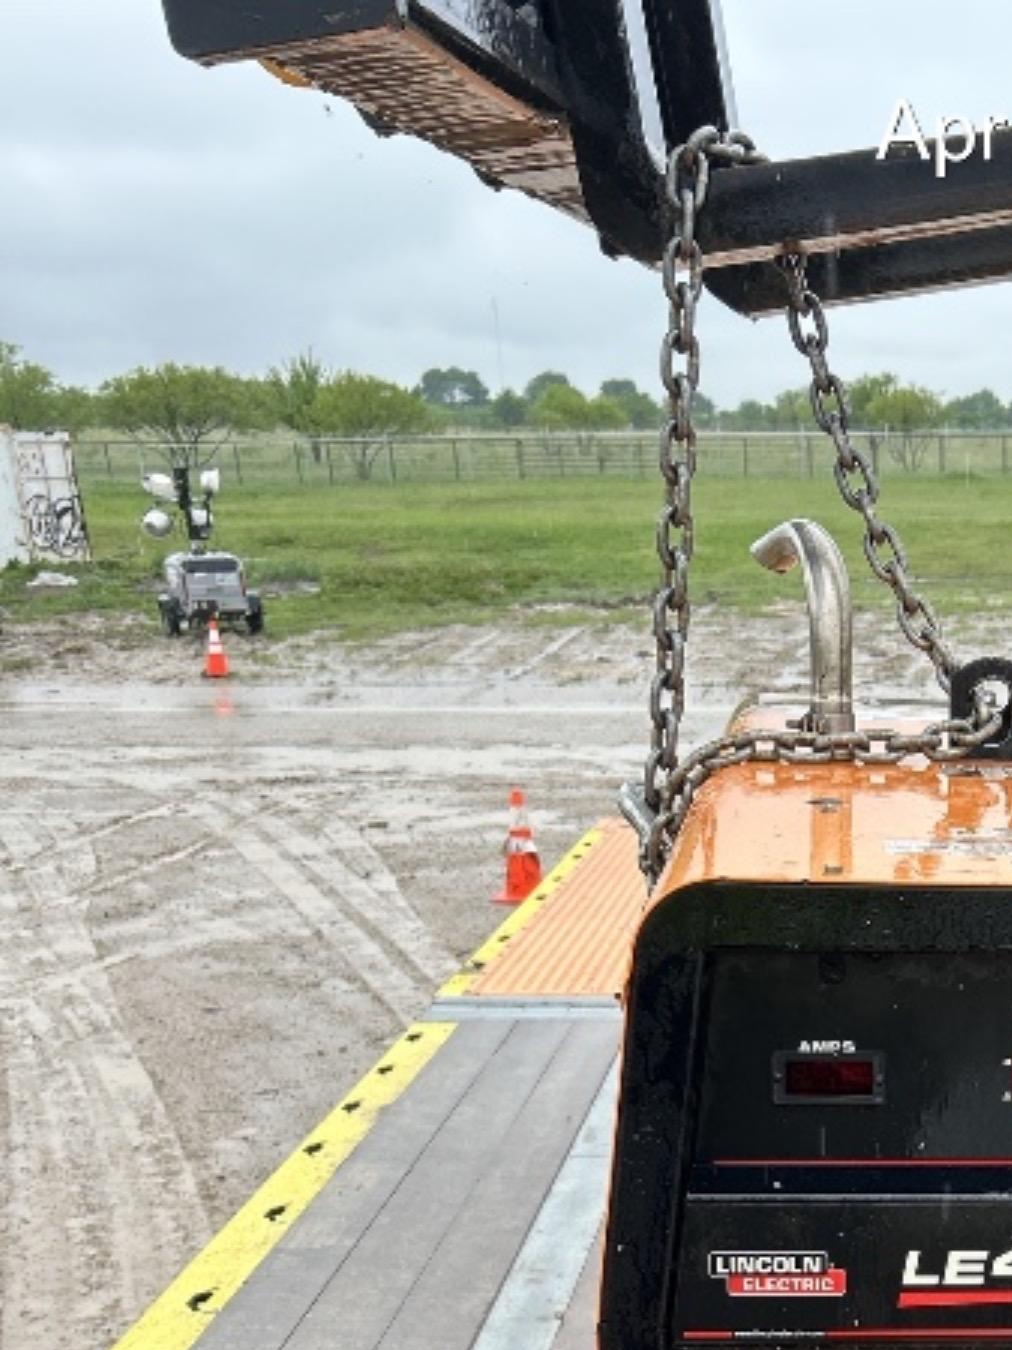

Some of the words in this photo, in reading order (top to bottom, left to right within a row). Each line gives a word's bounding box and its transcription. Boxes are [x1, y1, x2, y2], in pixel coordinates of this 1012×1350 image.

[798, 1040, 857, 1054] AMPS
[715, 1256, 822, 1274] LINCOLN
[743, 1277, 835, 1291] ELECTRIC
